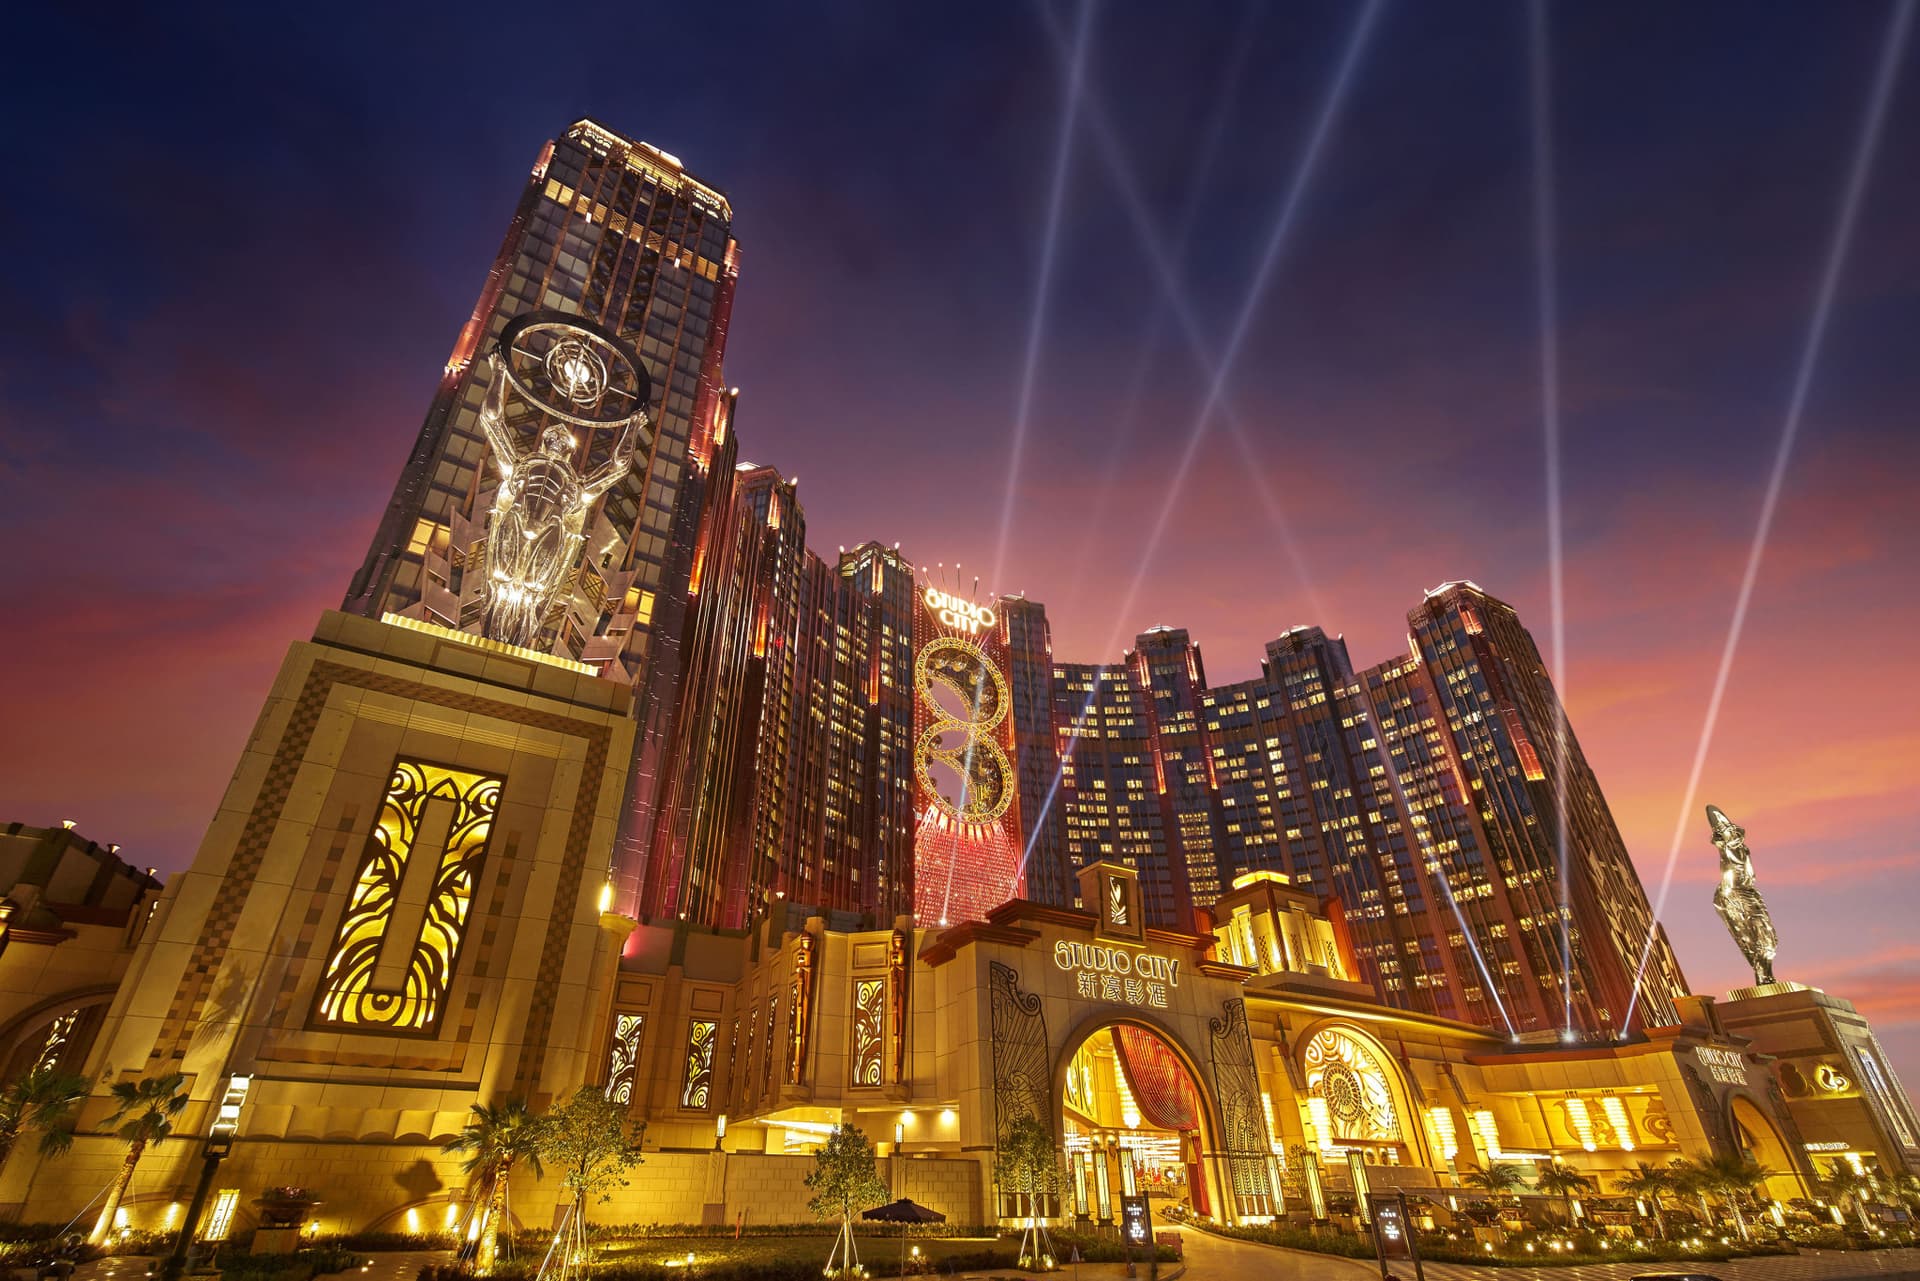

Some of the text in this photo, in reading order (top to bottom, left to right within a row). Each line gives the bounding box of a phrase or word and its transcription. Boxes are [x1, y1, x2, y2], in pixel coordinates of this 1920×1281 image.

[925, 588, 996, 626] STUDIO
[939, 609, 979, 634] CITY
[1055, 940, 1180, 987] STUDIO CITY
